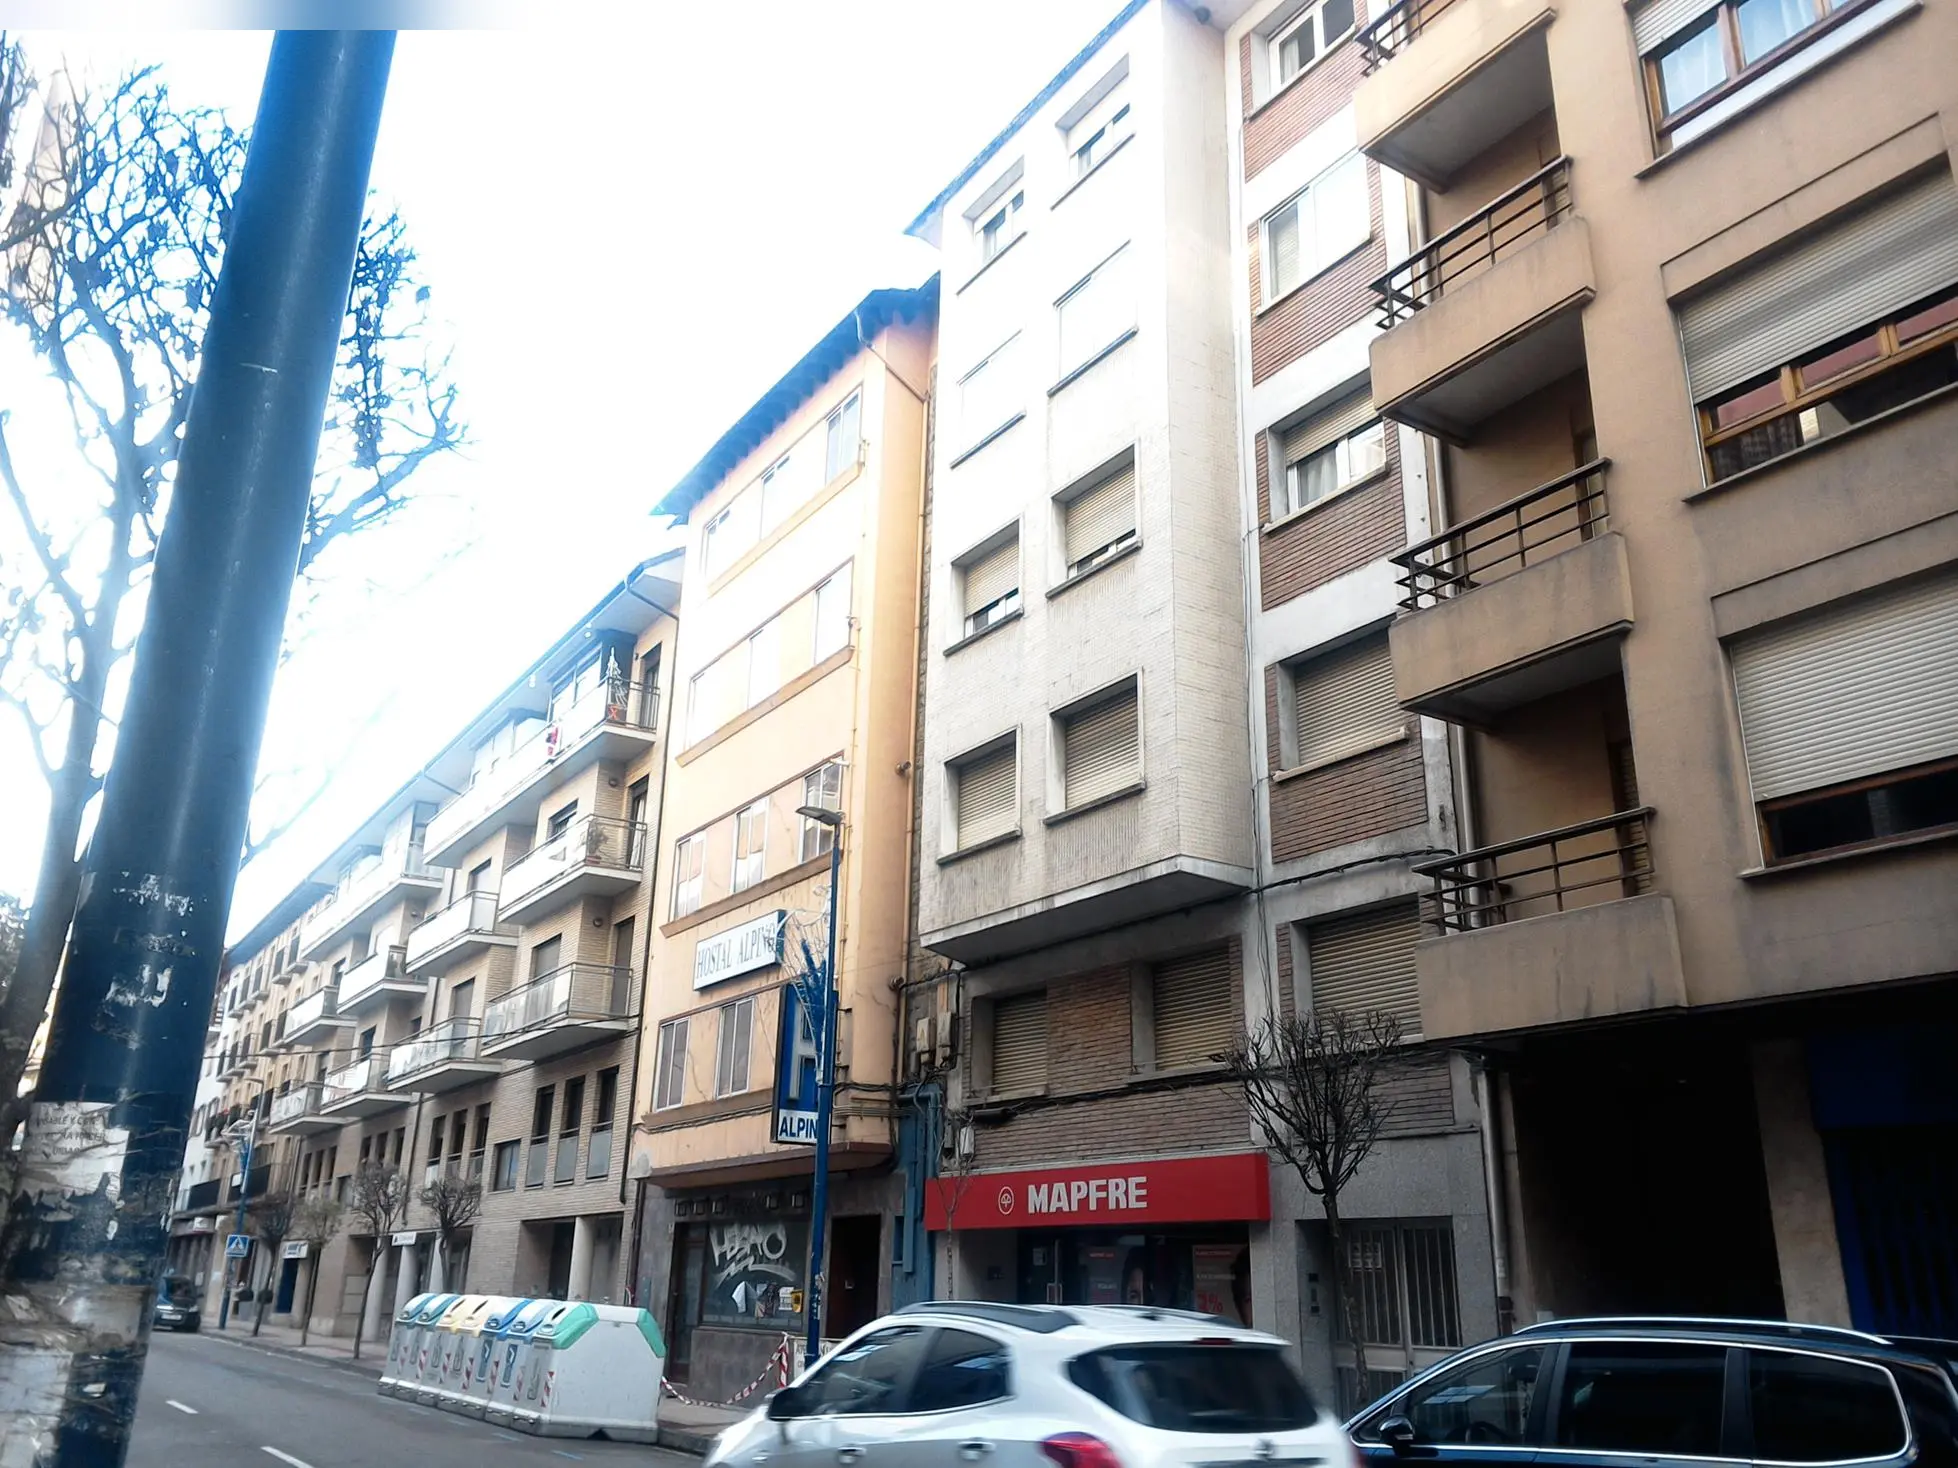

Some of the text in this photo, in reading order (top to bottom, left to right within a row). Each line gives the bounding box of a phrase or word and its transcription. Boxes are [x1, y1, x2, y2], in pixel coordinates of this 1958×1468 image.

[696, 938, 732, 980] HOSTAL
[779, 1115, 819, 1138] ALPIN
[1027, 1176, 1148, 1214] MAPFRE
